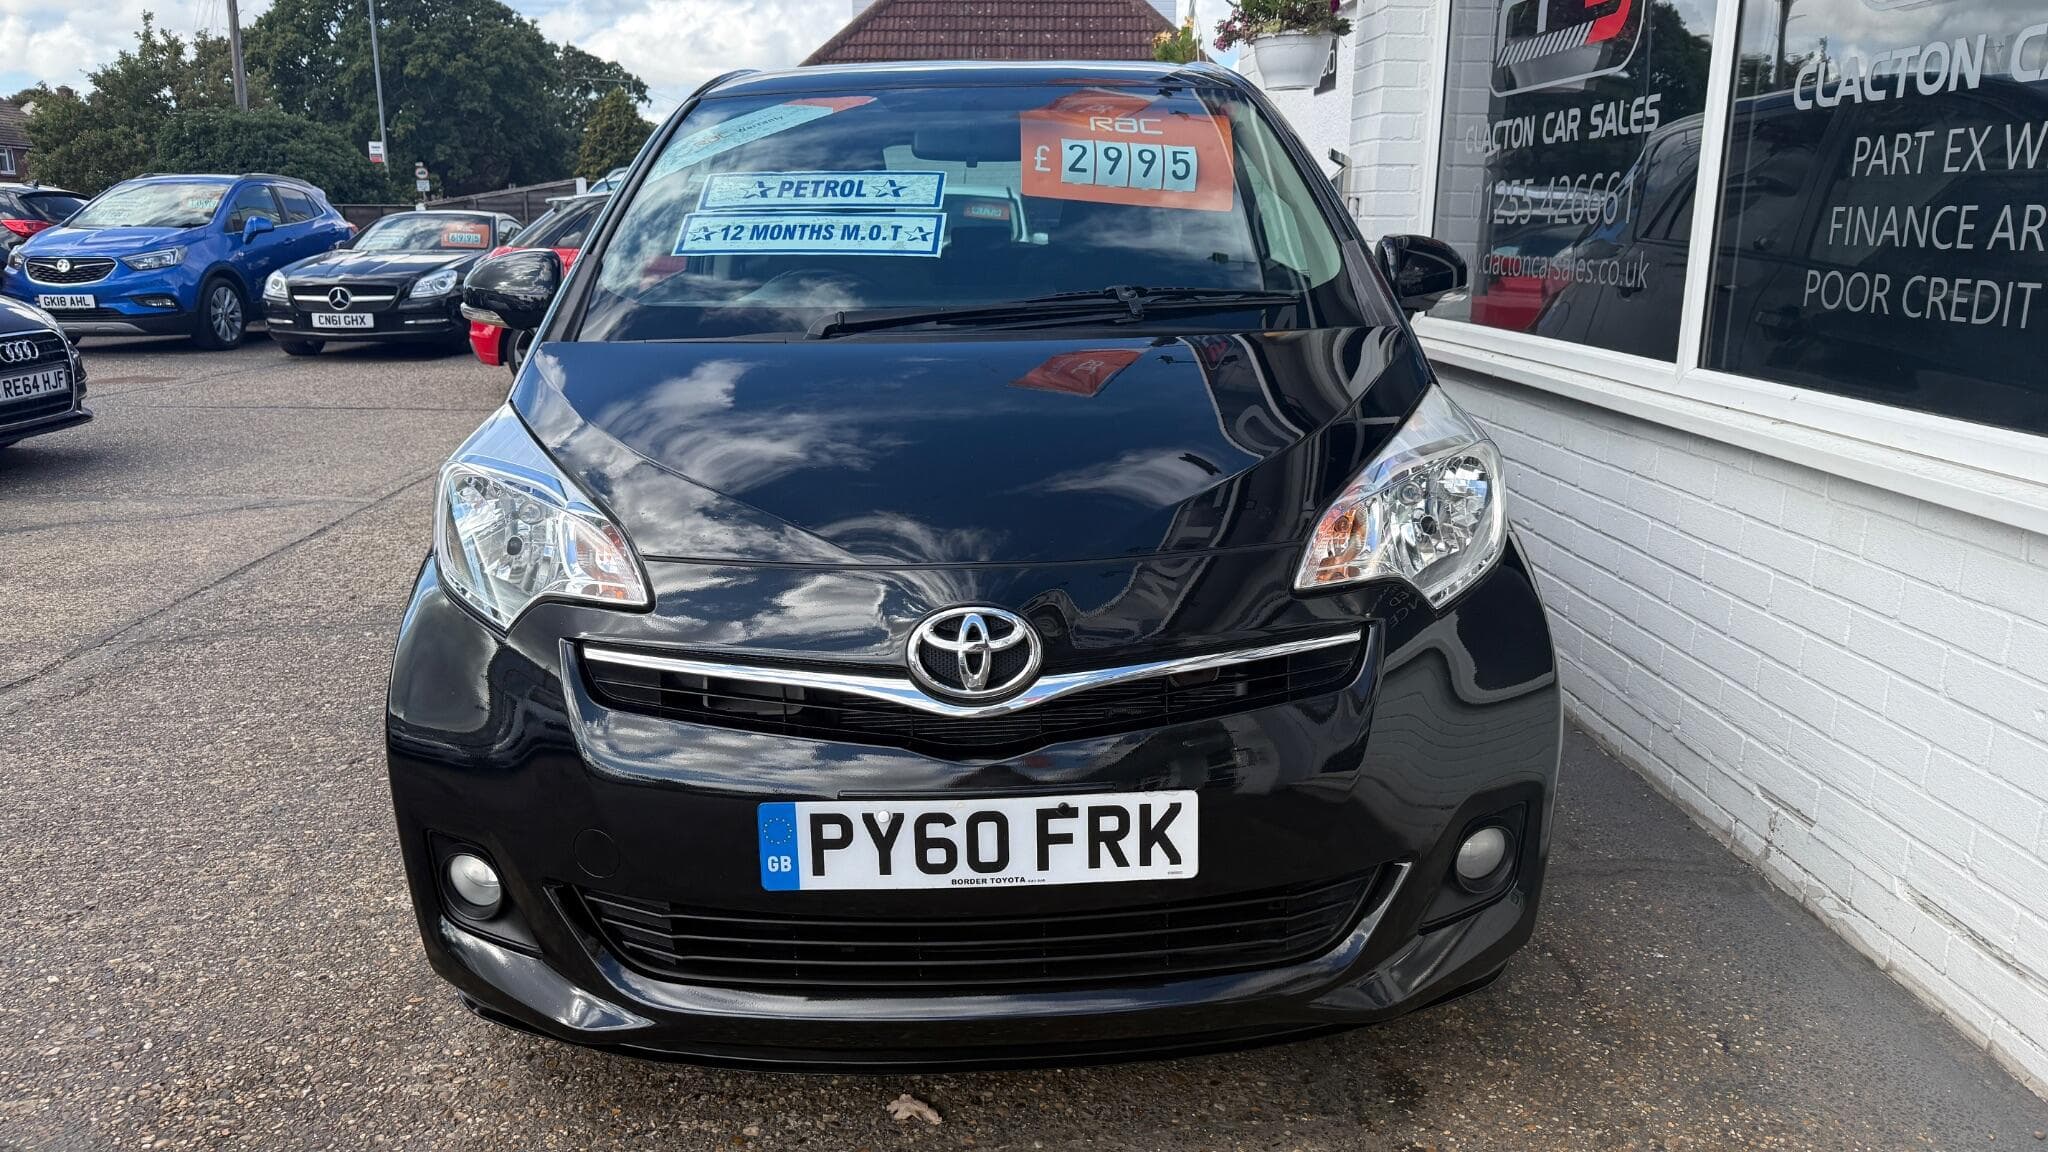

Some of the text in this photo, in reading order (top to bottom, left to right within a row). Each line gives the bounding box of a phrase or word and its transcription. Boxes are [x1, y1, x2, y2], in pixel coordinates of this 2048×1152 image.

[1793, 22, 2048, 110] CLACTON C
[1465, 93, 1662, 153] CLACTON CAR SALES
[1068, 144, 1191, 180] 2995
[1851, 130, 1935, 177] PART
[1943, 125, 1992, 173] EX
[777, 179, 867, 198] PETROL
[1471, 171, 1636, 225] 01255 426661
[721, 224, 903, 241] 12 MONTHS M.O.T
[1828, 204, 1979, 250] FINANCE
[43, 296, 90, 307] GK18 AHL
[1802, 269, 2043, 329] POOR CREDIT
[318, 315, 367, 326] CN61 GHX
[2, 370, 64, 399] RE64 HJF
[809, 802, 1183, 877] PY60 FRK
[767, 855, 792, 873] GB
[951, 878, 988, 886] BORDER
[990, 876, 1026, 884] TOYOTA
